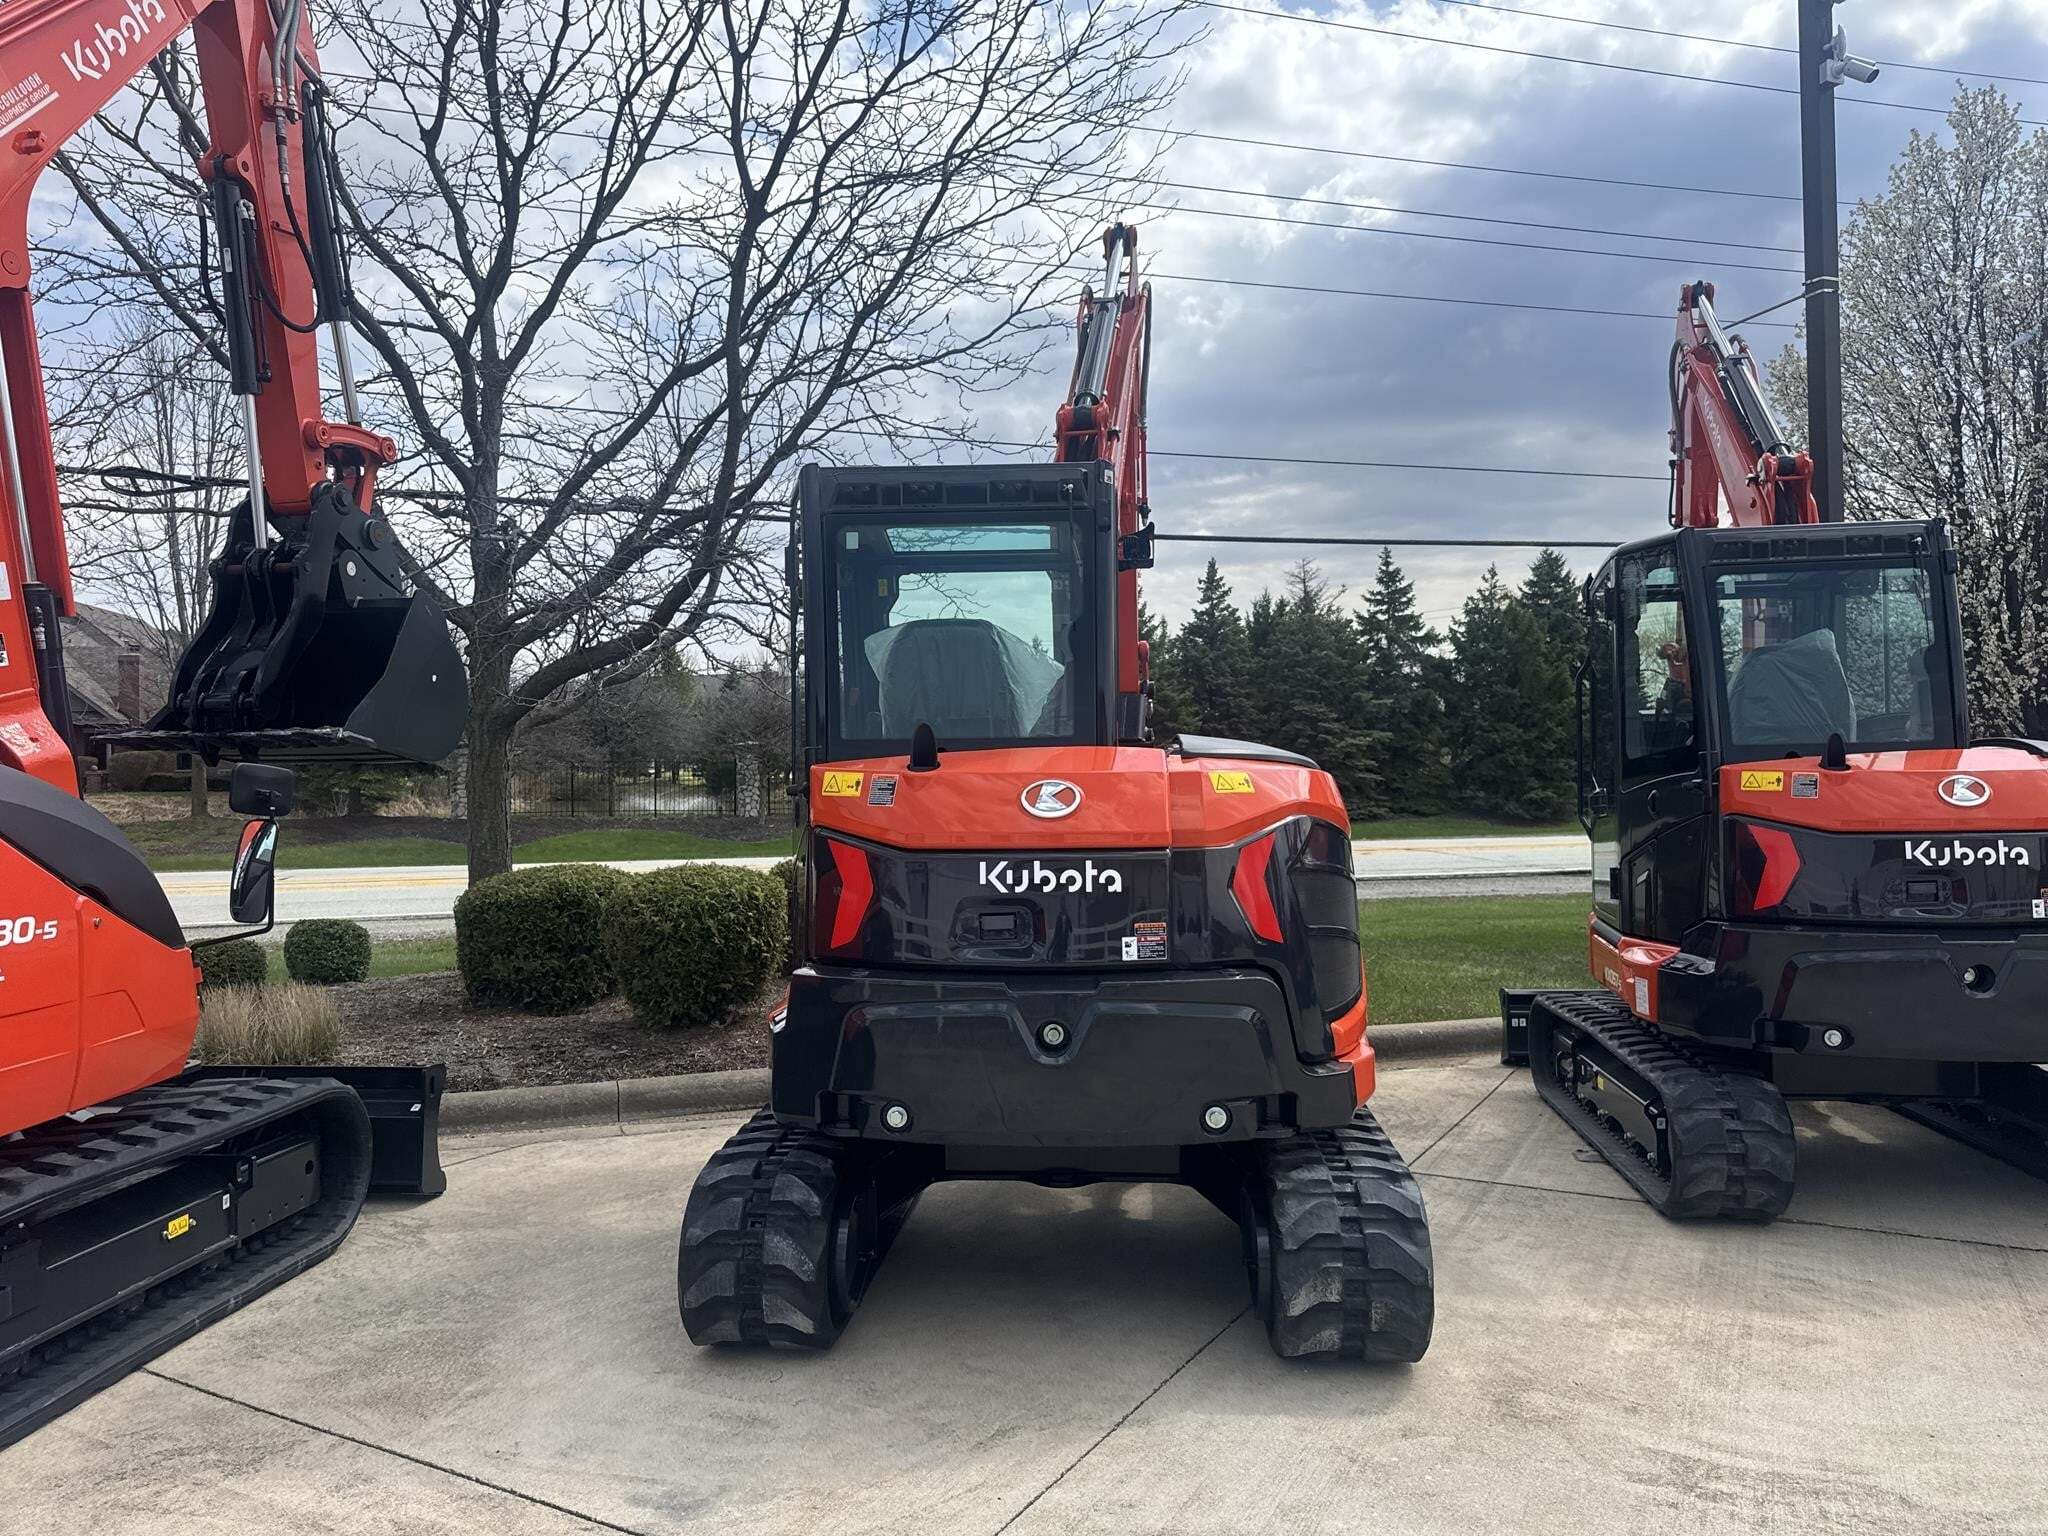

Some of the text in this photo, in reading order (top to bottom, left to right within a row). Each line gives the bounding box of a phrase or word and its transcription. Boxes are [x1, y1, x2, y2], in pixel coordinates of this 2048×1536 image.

[60, 0, 166, 81] Kubota
[0, 83, 50, 126] QUIPMENT GROUP
[1904, 840, 2029, 866] Kubota
[979, 860, 1122, 893] Kubota
